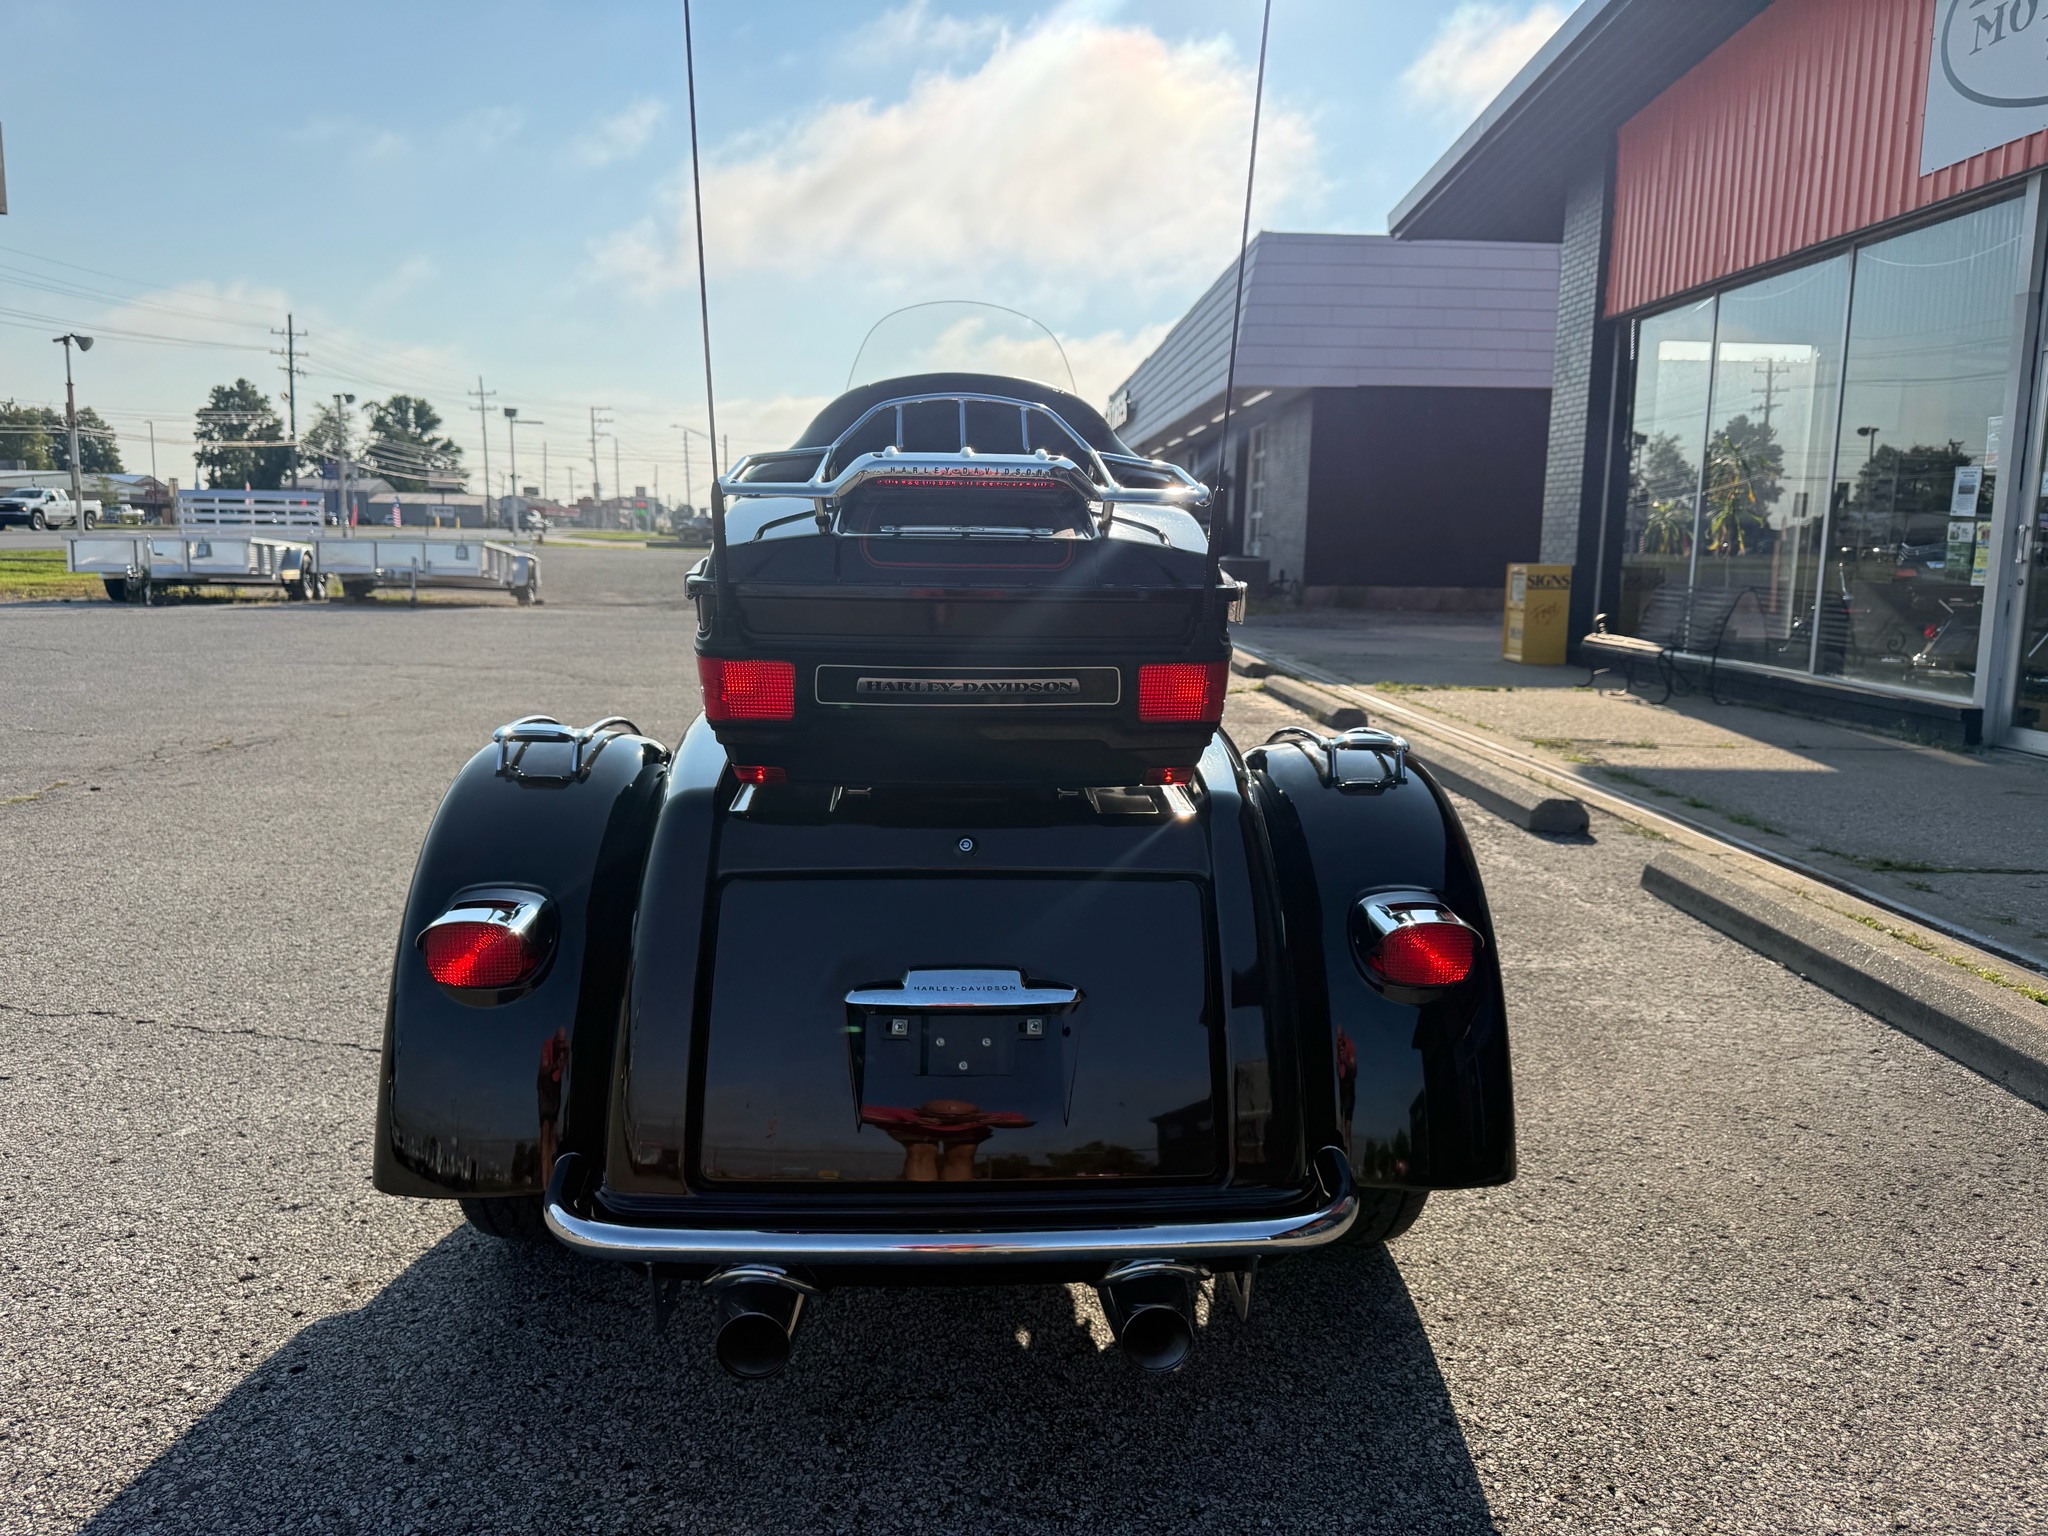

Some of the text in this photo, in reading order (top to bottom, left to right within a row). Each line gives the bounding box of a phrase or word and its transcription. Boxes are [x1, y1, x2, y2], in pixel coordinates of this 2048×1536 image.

[1969, 0, 2048, 56] MO
[890, 466, 1043, 477] HARLEY-DAVIDSON
[1527, 574, 1570, 587] SIGNS
[865, 680, 1074, 693] HARLEY-DAVIDSON
